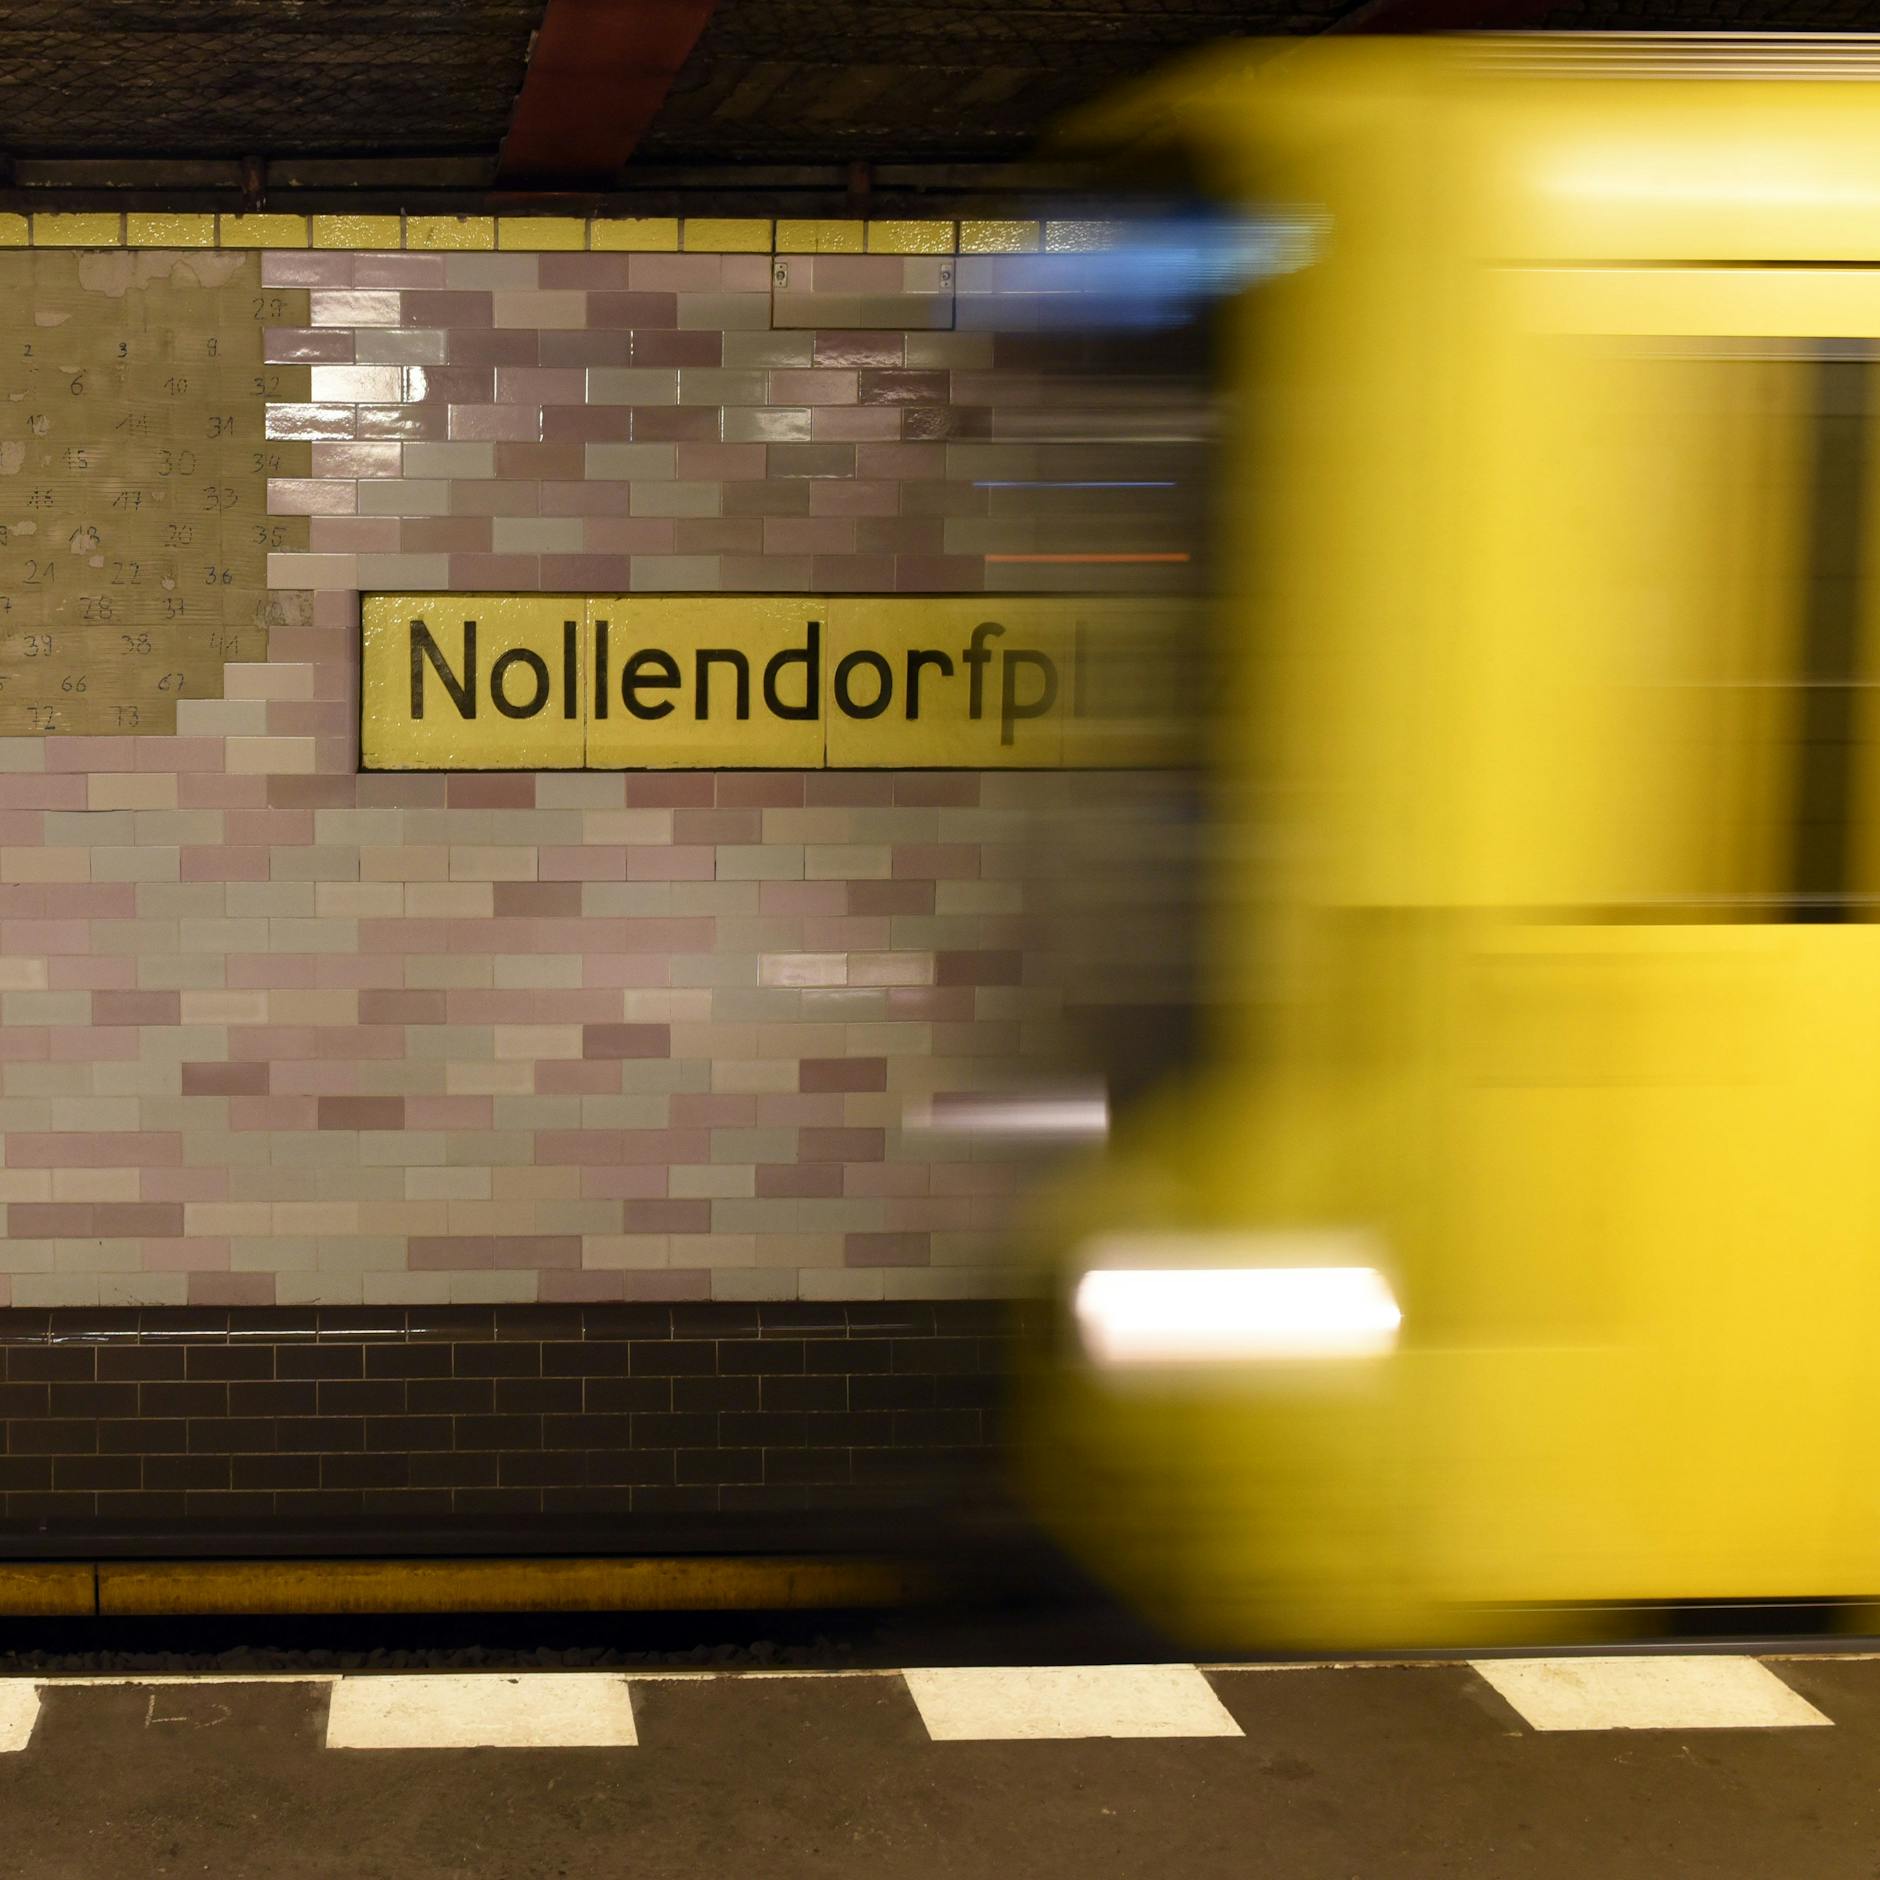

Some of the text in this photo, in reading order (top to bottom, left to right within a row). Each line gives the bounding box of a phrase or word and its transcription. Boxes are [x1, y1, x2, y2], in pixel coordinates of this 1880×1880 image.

[24, 344, 34, 357] 2
[118, 343, 128, 357] 3
[70, 374, 84, 396] 6
[163, 376, 188, 396] 10
[253, 377, 281, 397] 32
[207, 416, 234, 438] 31
[158, 450, 198, 476] 30
[253, 452, 281, 473] 34
[253, 525, 287, 547] 35
[23, 559, 55, 584] 21
[111, 562, 142, 585] 22
[204, 566, 234, 585] 36
[23, 634, 53, 657] 39
[121, 634, 151, 655] 38
[61, 675, 88, 692] 66
[157, 673, 185, 691] 67
[27, 705, 56, 730] 72
[109, 705, 139, 727] 73
